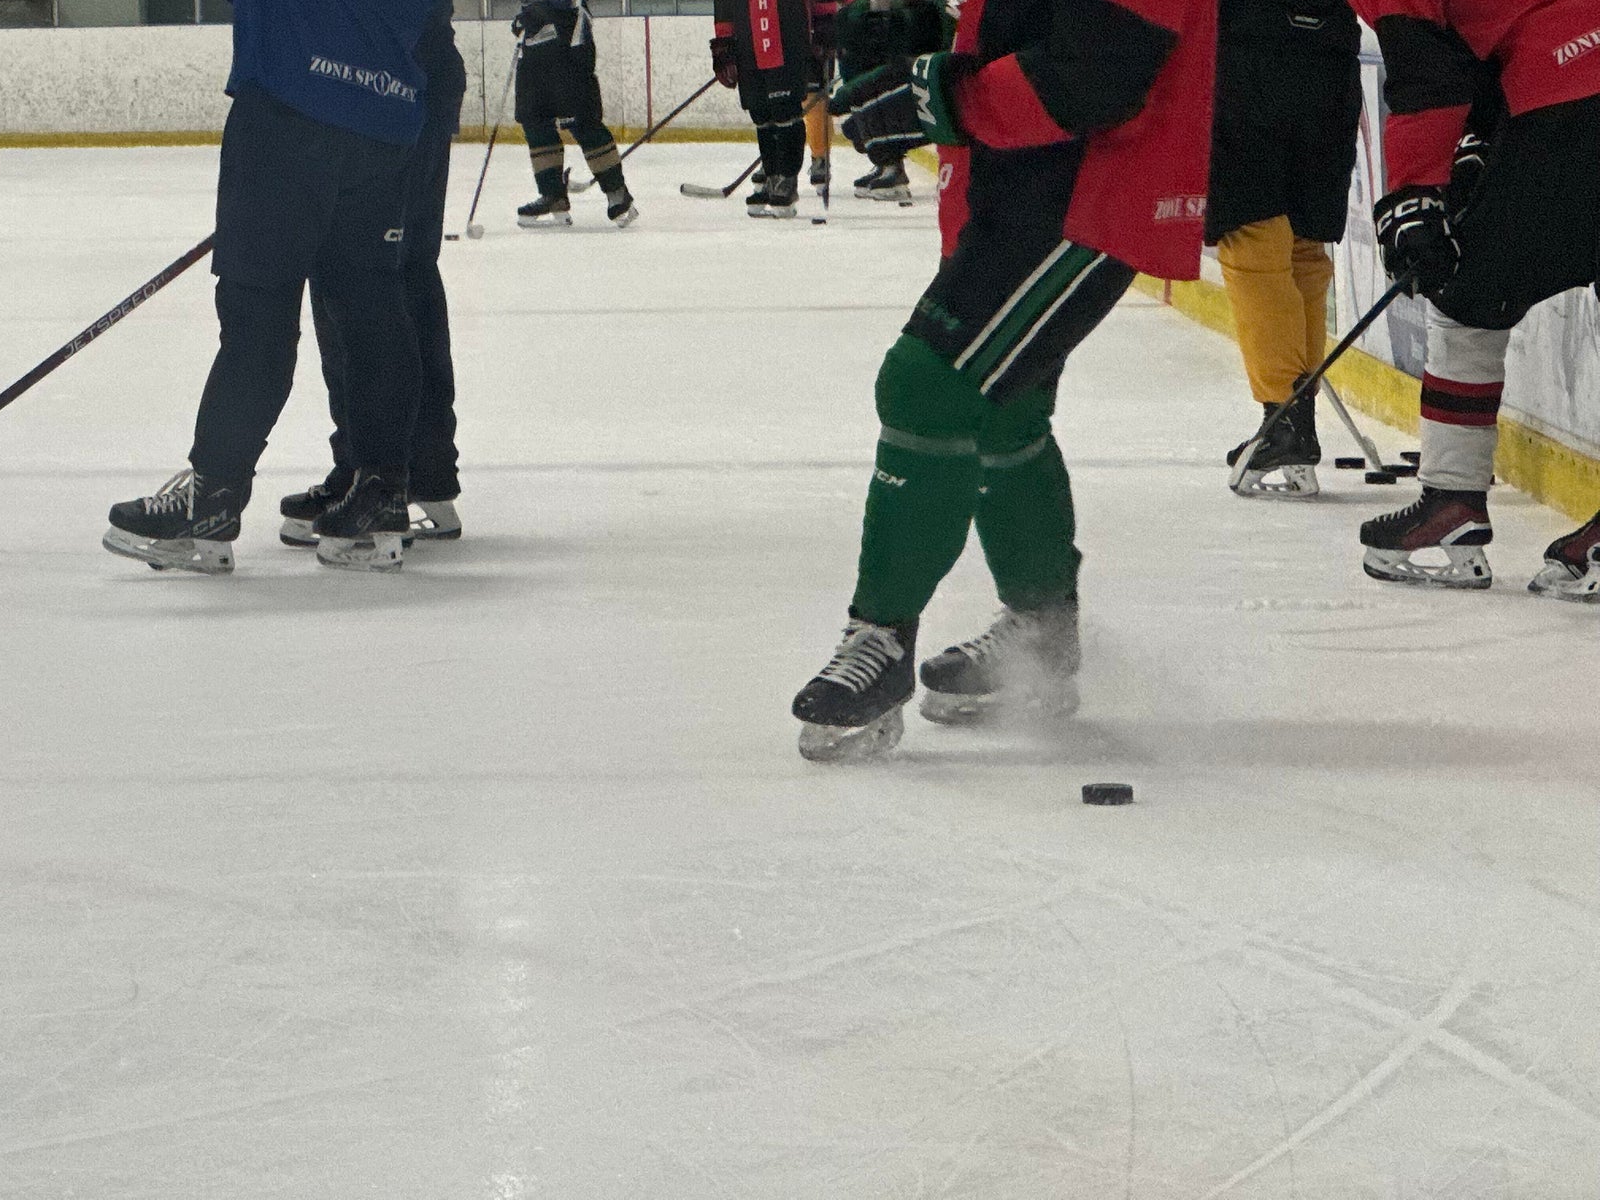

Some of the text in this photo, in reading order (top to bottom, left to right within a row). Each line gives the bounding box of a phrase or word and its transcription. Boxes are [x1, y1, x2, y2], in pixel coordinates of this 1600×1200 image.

[309, 56, 352, 81] ZONE
[1377, 196, 1445, 237] CCM
[64, 282, 157, 359] JETSPEED
